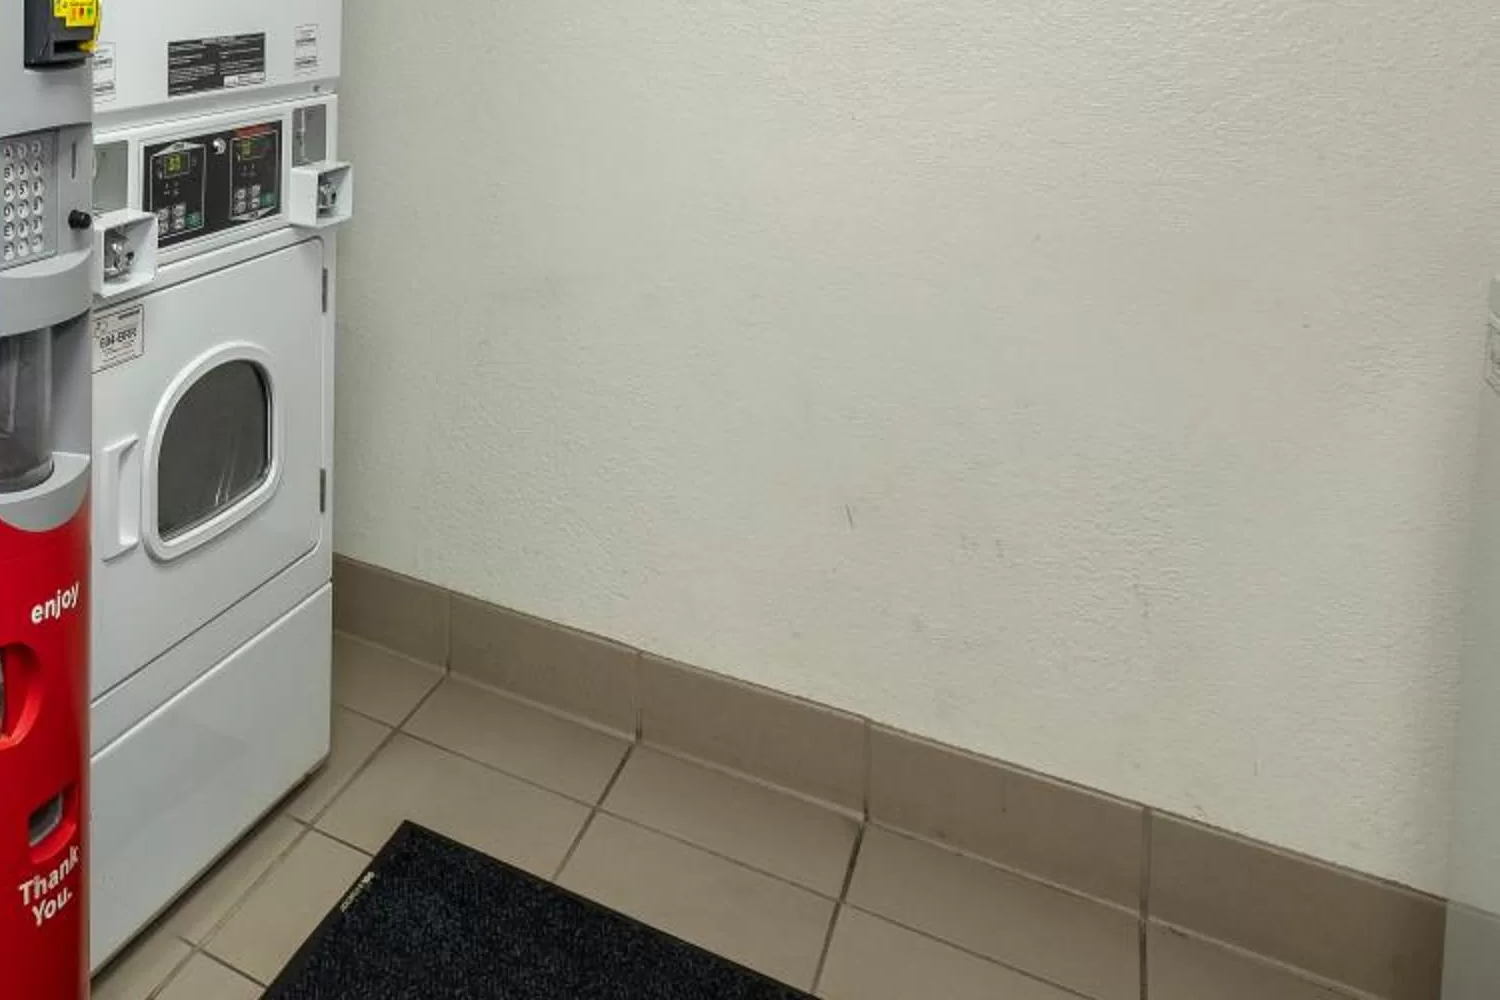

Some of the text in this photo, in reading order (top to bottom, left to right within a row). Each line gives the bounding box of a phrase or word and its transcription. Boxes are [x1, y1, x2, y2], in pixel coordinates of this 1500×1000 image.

[31, 581, 81, 625] enjoy
[18, 844, 80, 906] Thank
[31, 891, 74, 929] You.
